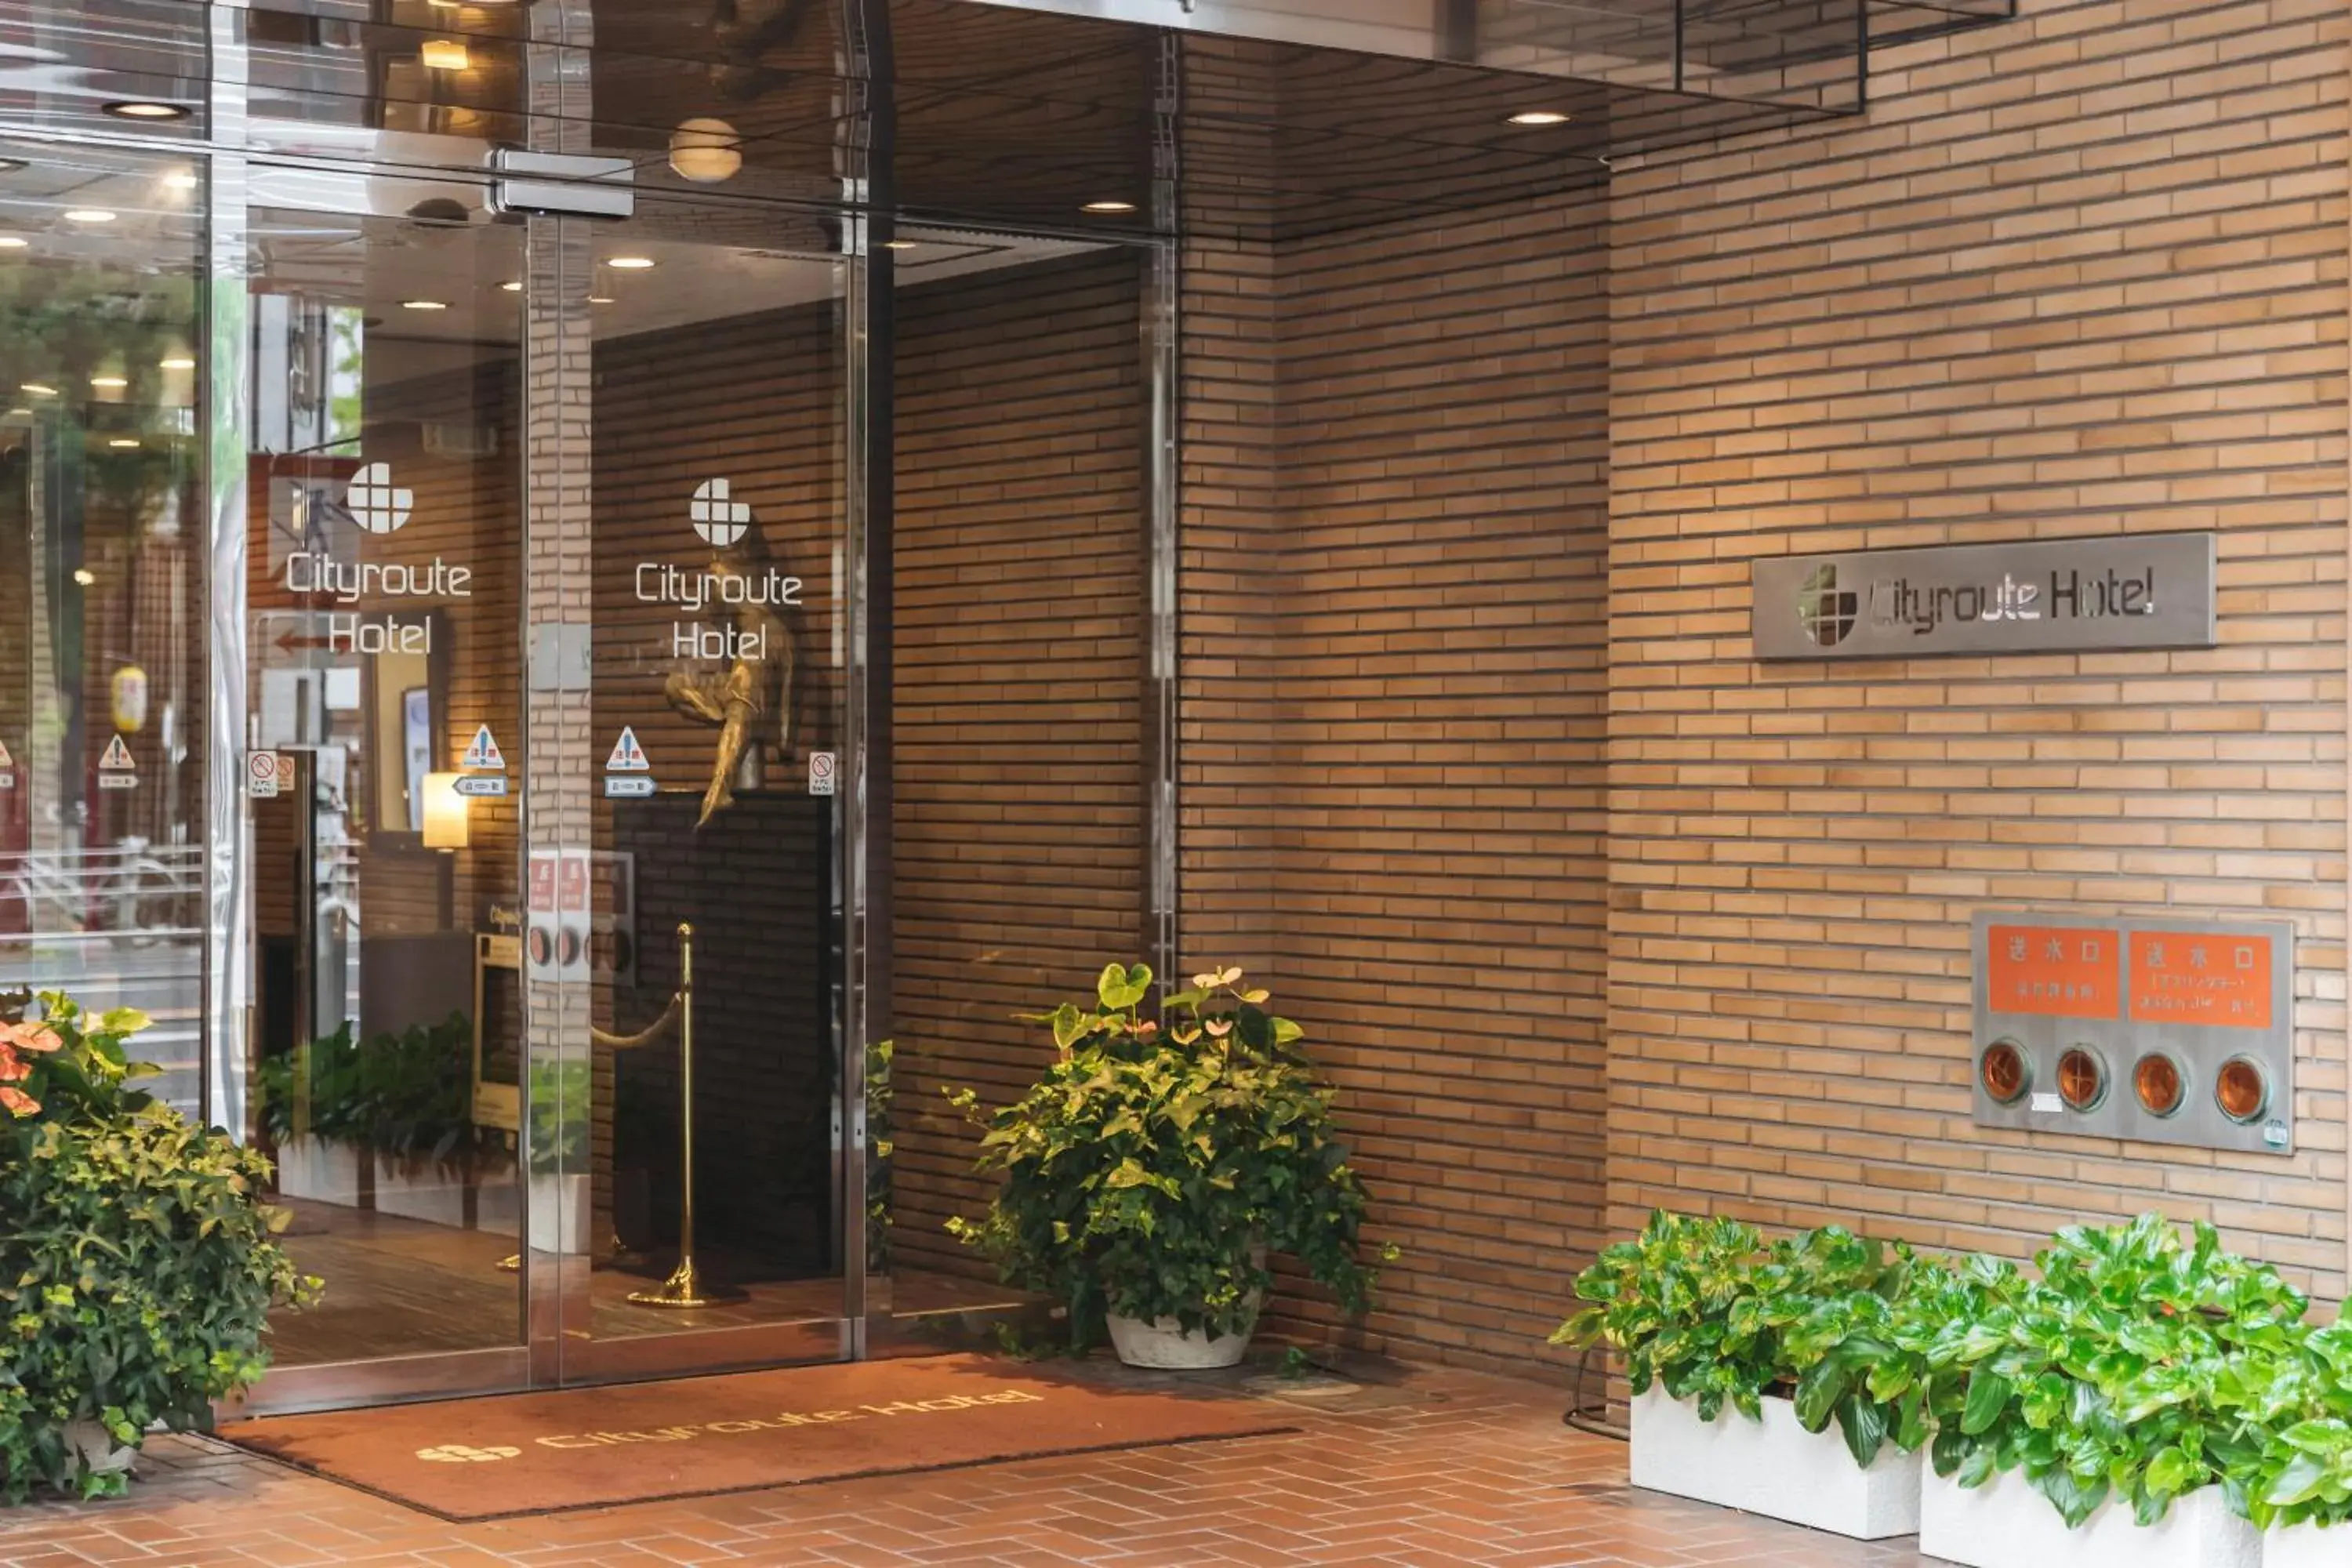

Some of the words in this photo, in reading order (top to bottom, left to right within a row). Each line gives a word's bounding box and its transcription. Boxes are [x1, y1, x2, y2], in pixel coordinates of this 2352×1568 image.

[286, 551, 471, 603] Cityroute
[635, 562, 803, 612] Cityroute
[1871, 572, 2042, 636] Cityroute
[2050, 566, 2154, 619] Hotel
[328, 614, 430, 655] Hotel
[673, 621, 766, 660] Hotel
[2008, 935, 2100, 964] 送水口
[2147, 941, 2254, 970] 送水口
[535, 1410, 865, 1450] Cityroute
[860, 1389, 1045, 1417] Hotel
